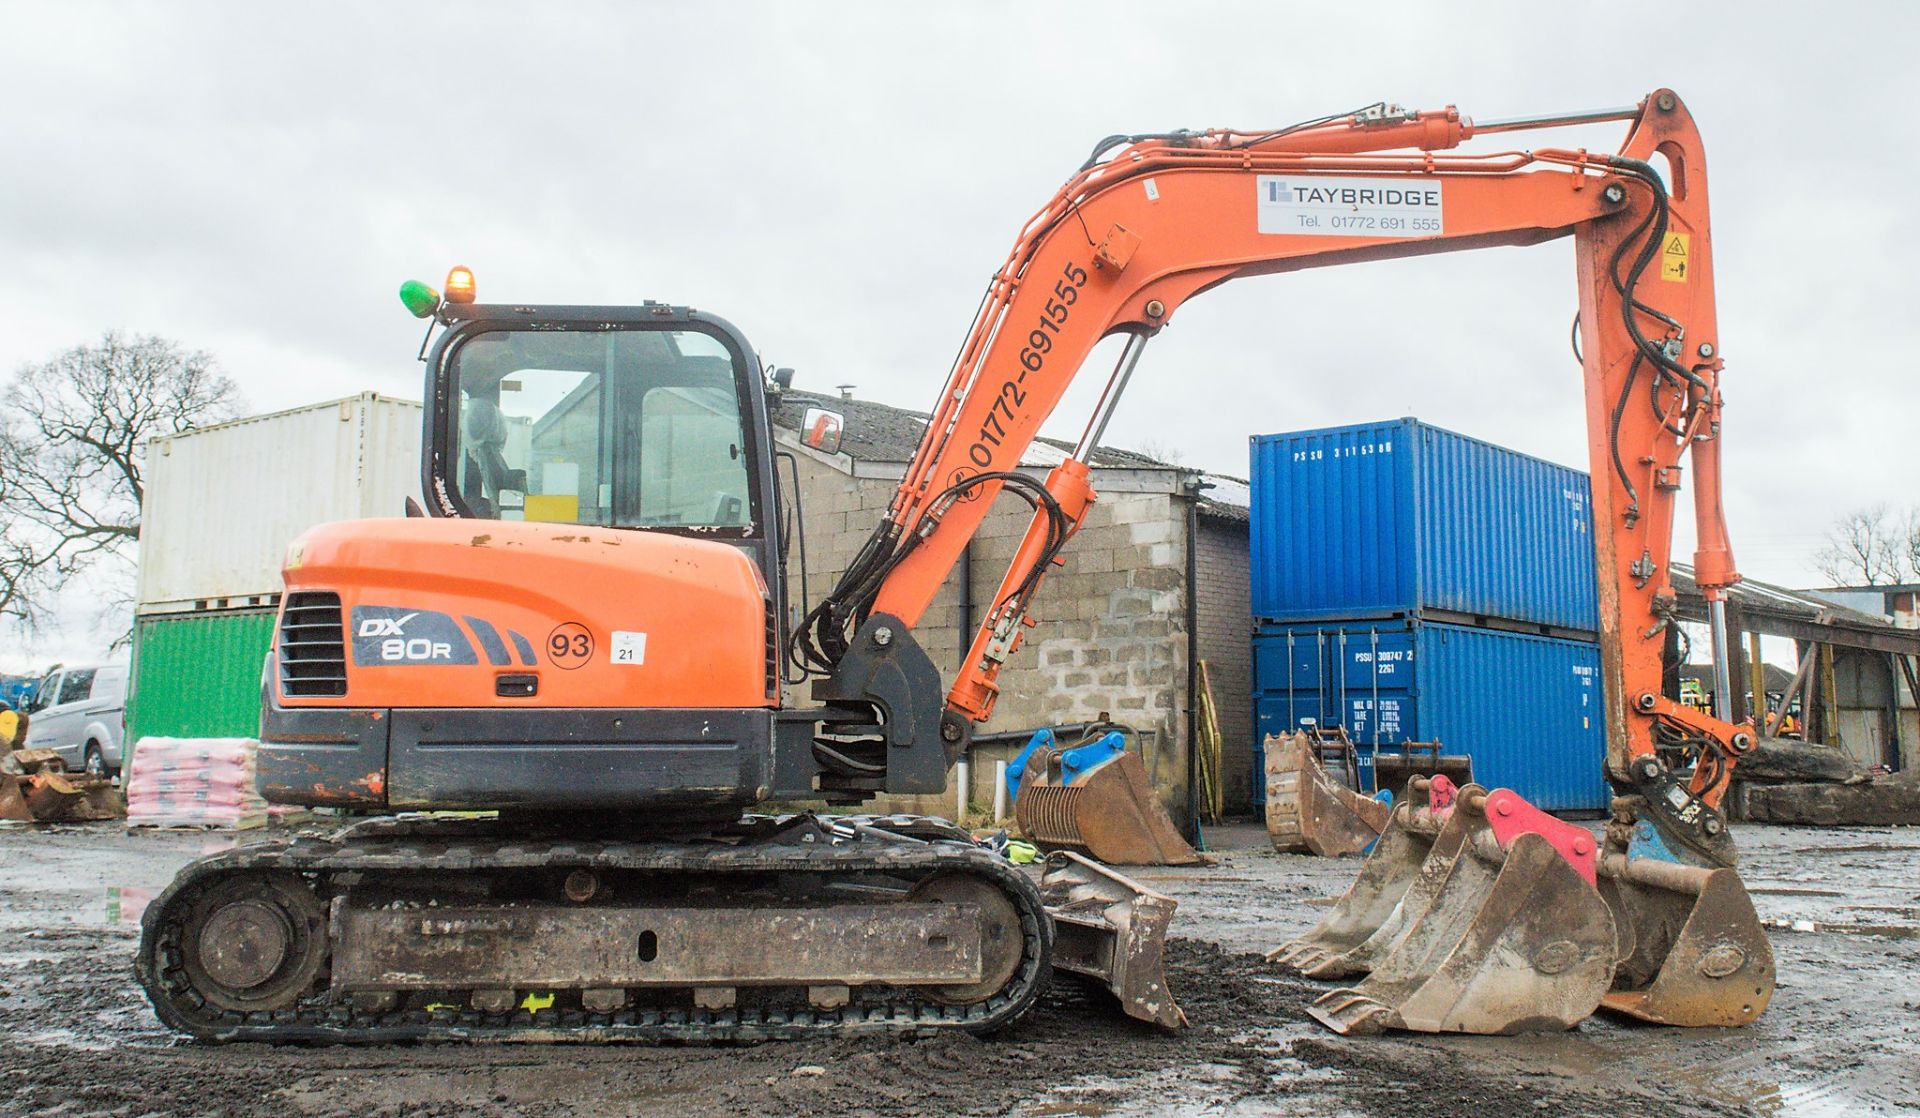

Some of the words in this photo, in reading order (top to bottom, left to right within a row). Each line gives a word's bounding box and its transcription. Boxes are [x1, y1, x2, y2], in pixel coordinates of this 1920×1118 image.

[1294, 187, 1439, 207] TAYBRIDGE
[1297, 214, 1321, 228] Tel.
[1331, 215, 1375, 229] 01772
[1380, 217, 1406, 230] 691
[1412, 218, 1440, 231] 555
[969, 262, 1088, 468] 01772-691555
[359, 612, 420, 637] DX
[381, 638, 452, 660] 80R
[551, 634, 589, 657] 93
[618, 649, 634, 660] 21
[1355, 652, 1373, 663] PSSU
